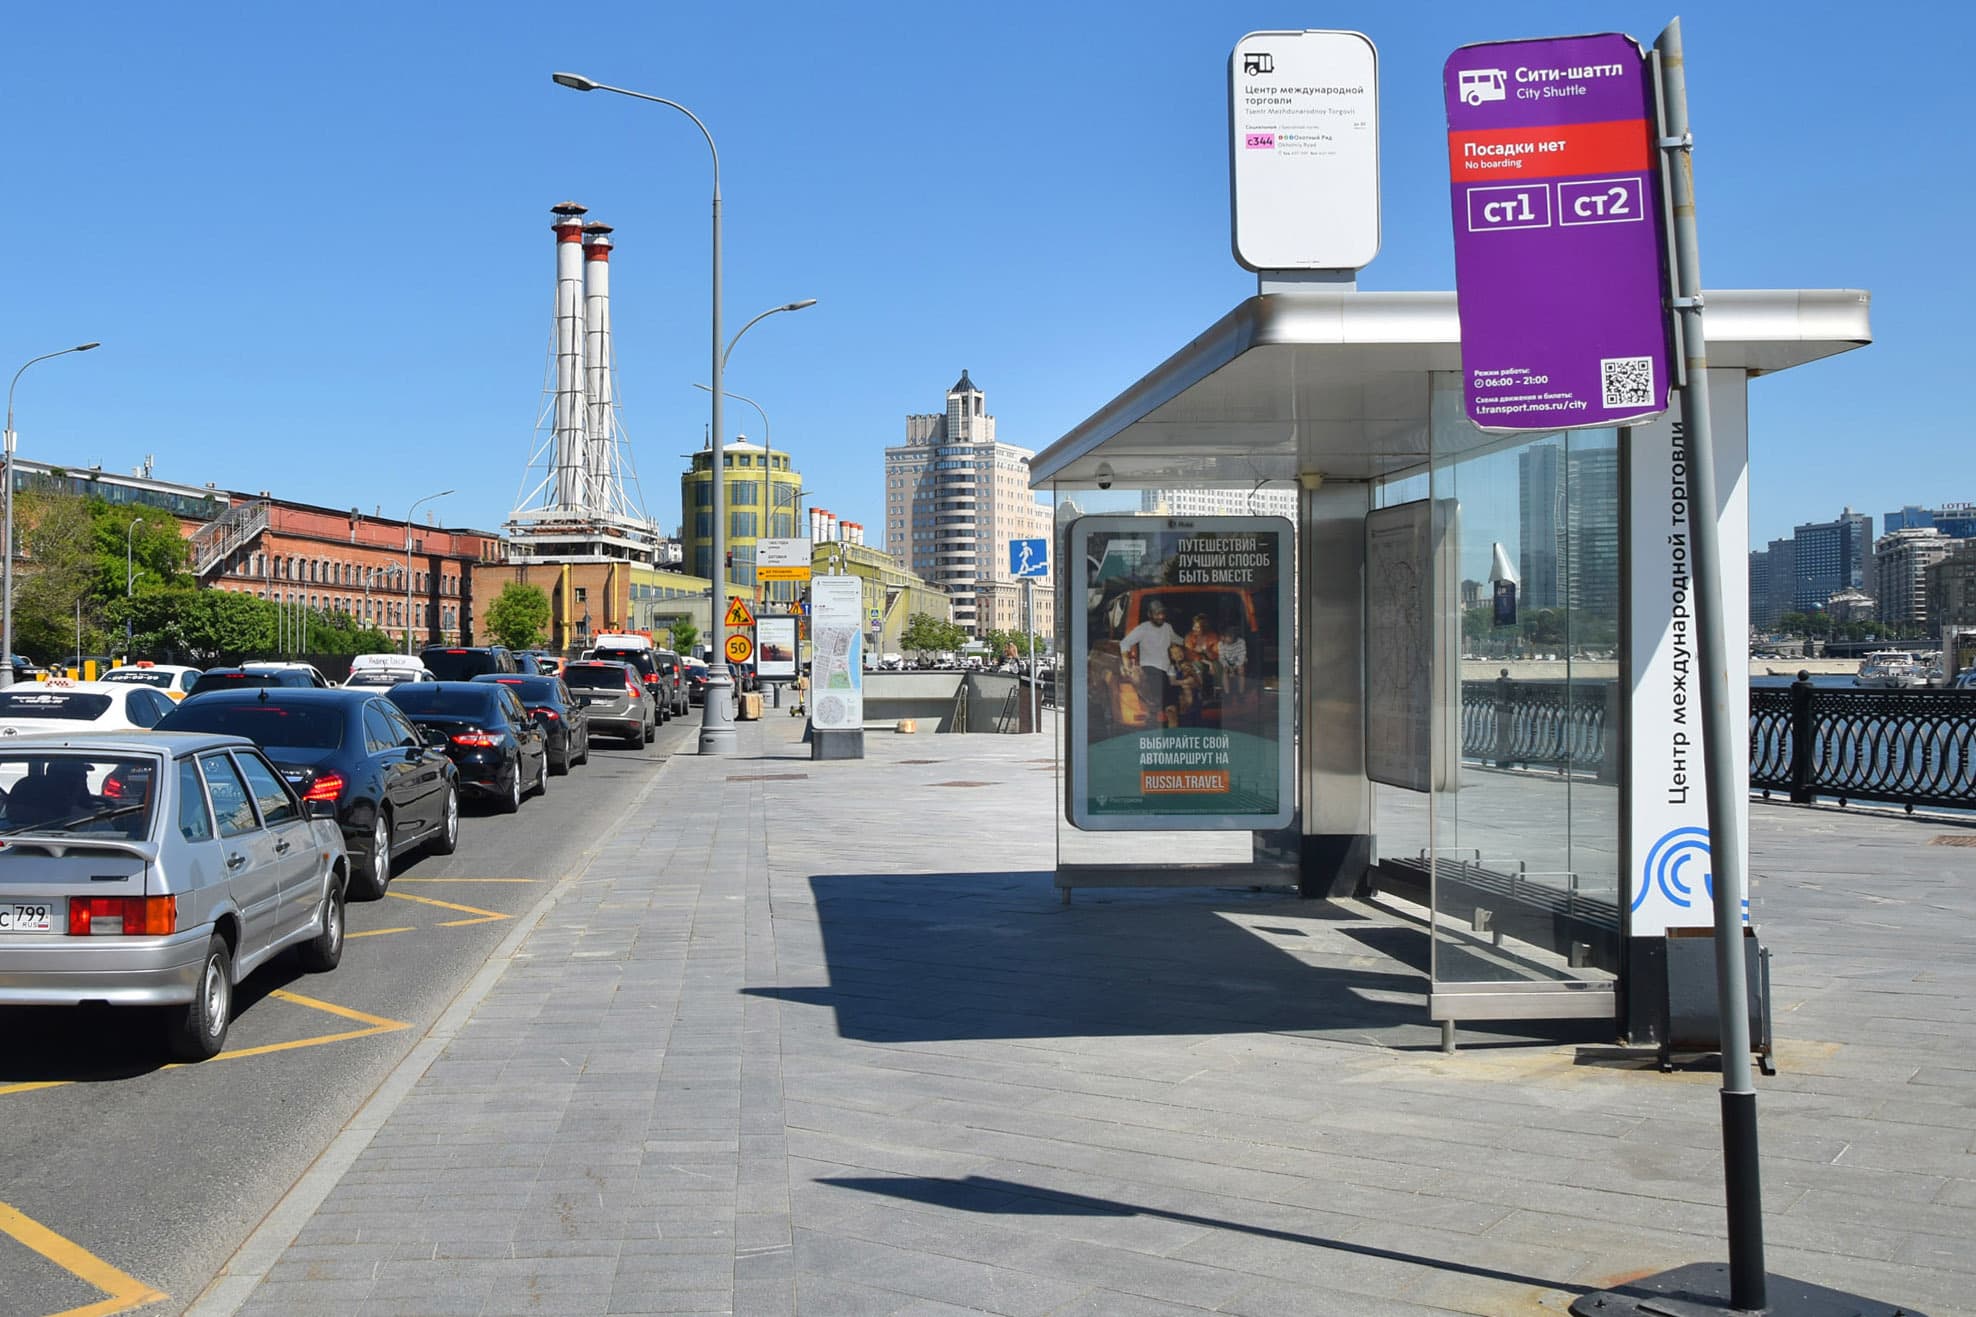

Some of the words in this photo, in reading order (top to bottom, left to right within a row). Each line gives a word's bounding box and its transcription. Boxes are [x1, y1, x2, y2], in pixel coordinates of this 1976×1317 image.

[1515, 64, 1623, 82] Сити-шаттл
[1245, 85, 1277, 95] Центр
[1280, 86, 1364, 96] международной
[1517, 87, 1540, 100] City
[1543, 84, 1587, 98] Shuttle
[1246, 97, 1292, 106] торговли
[1247, 136, 1273, 146] с344
[1464, 142, 1534, 157] Посадки
[1538, 140, 1566, 152] нет
[1465, 160, 1479, 169] No
[1481, 159, 1523, 169] boarding
[1483, 193, 1535, 223] ст1
[1574, 187, 1630, 217] ст2
[1474, 369, 1500, 377] Режим
[1500, 368, 1531, 377] работы:
[1485, 377, 1513, 387] 06:00
[1523, 375, 1549, 385] 21:00
[1475, 396, 1499, 404] Схема
[1499, 394, 1537, 402] движения
[1543, 392, 1573, 400] билеты:
[1671, 422, 1688, 527] торговли
[1179, 539, 1256, 552] ПУТЕШЕСТВИЯ
[1179, 552, 1226, 568] ЛУЧШИЙ
[1228, 553, 1270, 566] СПОСОБ
[1179, 569, 1210, 583] БЫТЬ
[1211, 569, 1254, 583] ВМЕСТЕ
[1667, 533, 1690, 724] международной
[731, 642, 747, 654] 50
[1139, 735, 1201, 749] ВЫБИРАЙТЕ
[1203, 734, 1229, 749] СВОЙ
[1139, 752, 1213, 765] АВТОМАРШРУТ
[1215, 752, 1229, 764] НА
[1668, 732, 1690, 804] Центр
[1145, 775, 1224, 789] RUSSIA.TRAVEL
[15, 906, 46, 922] 799
